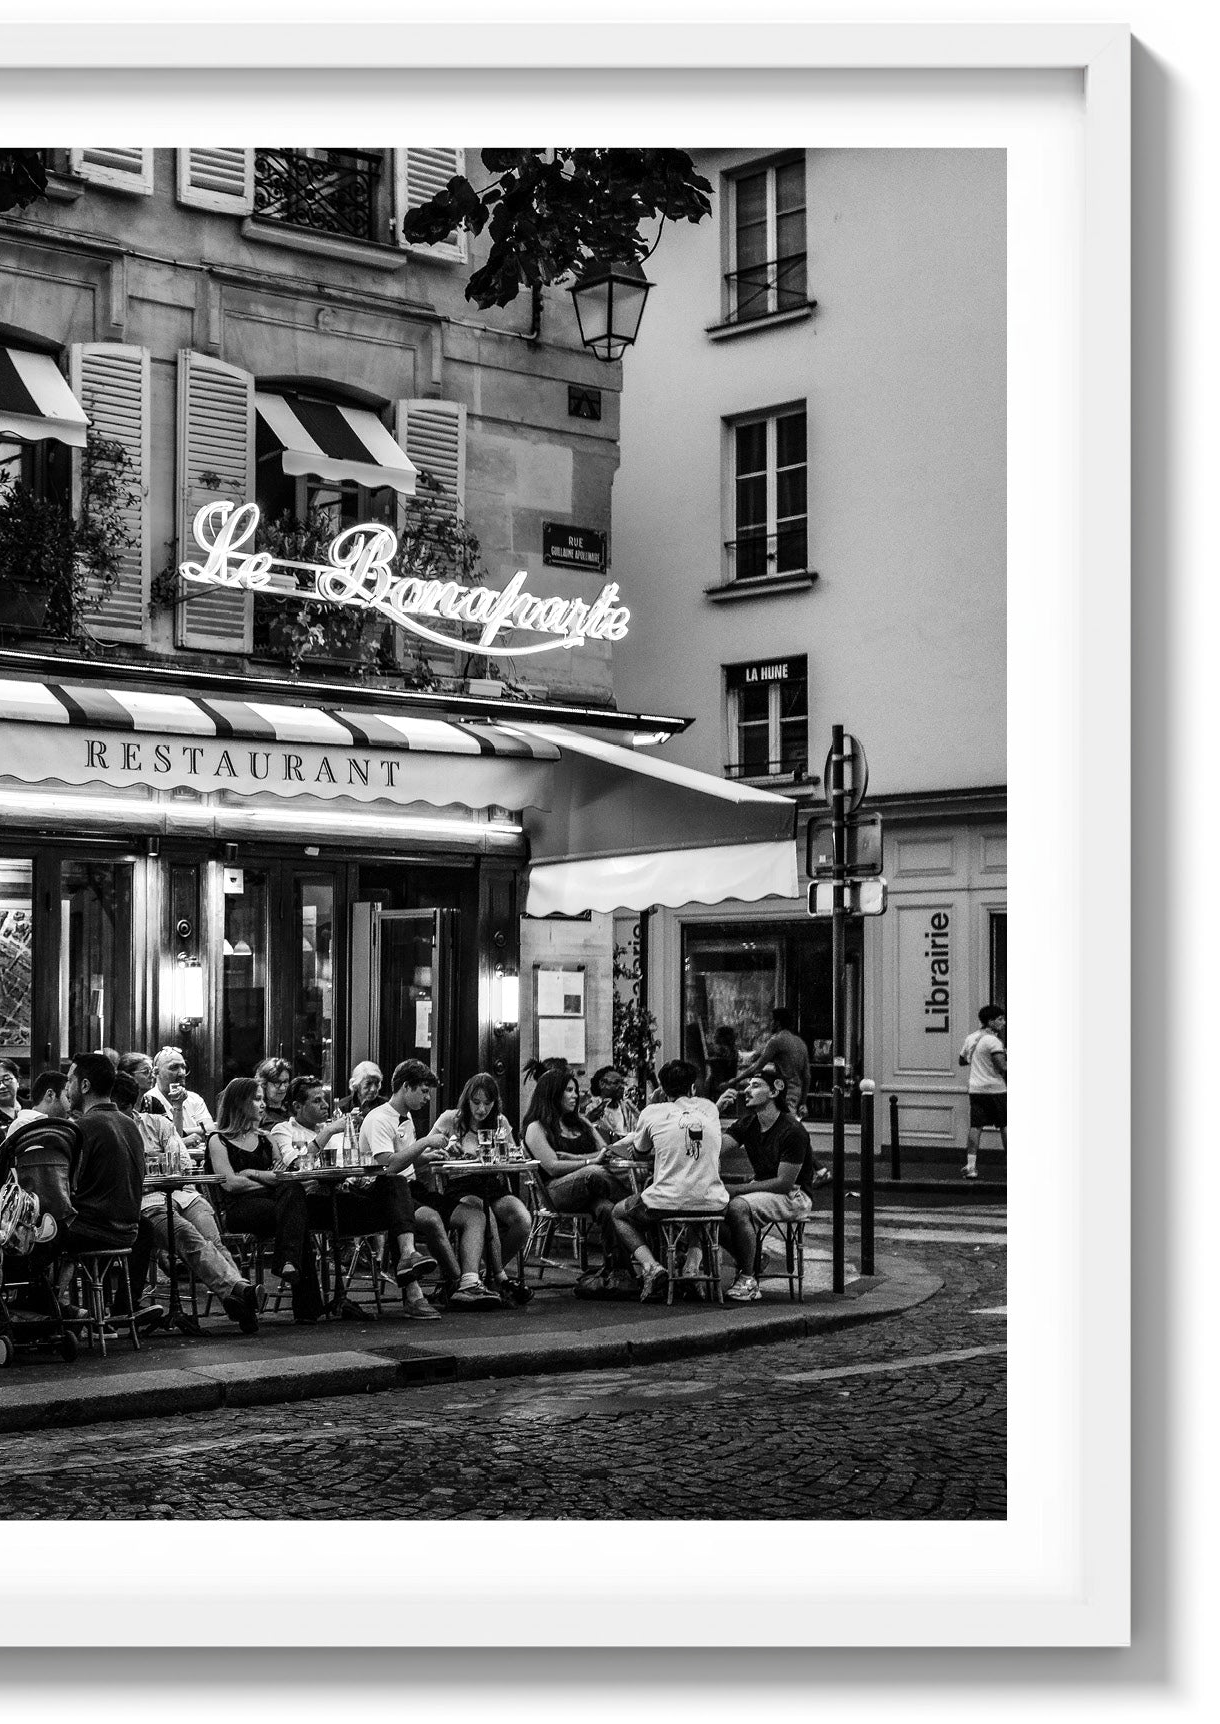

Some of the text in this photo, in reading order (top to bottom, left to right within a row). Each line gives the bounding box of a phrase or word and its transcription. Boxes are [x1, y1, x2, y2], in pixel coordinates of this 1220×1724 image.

[569, 536, 584, 548] RUE
[179, 500, 632, 648] Le Bonaparte
[746, 664, 788, 682] LA HUNE
[84, 739, 400, 787] RESTAURANT
[925, 912, 949, 1033] Librairie
